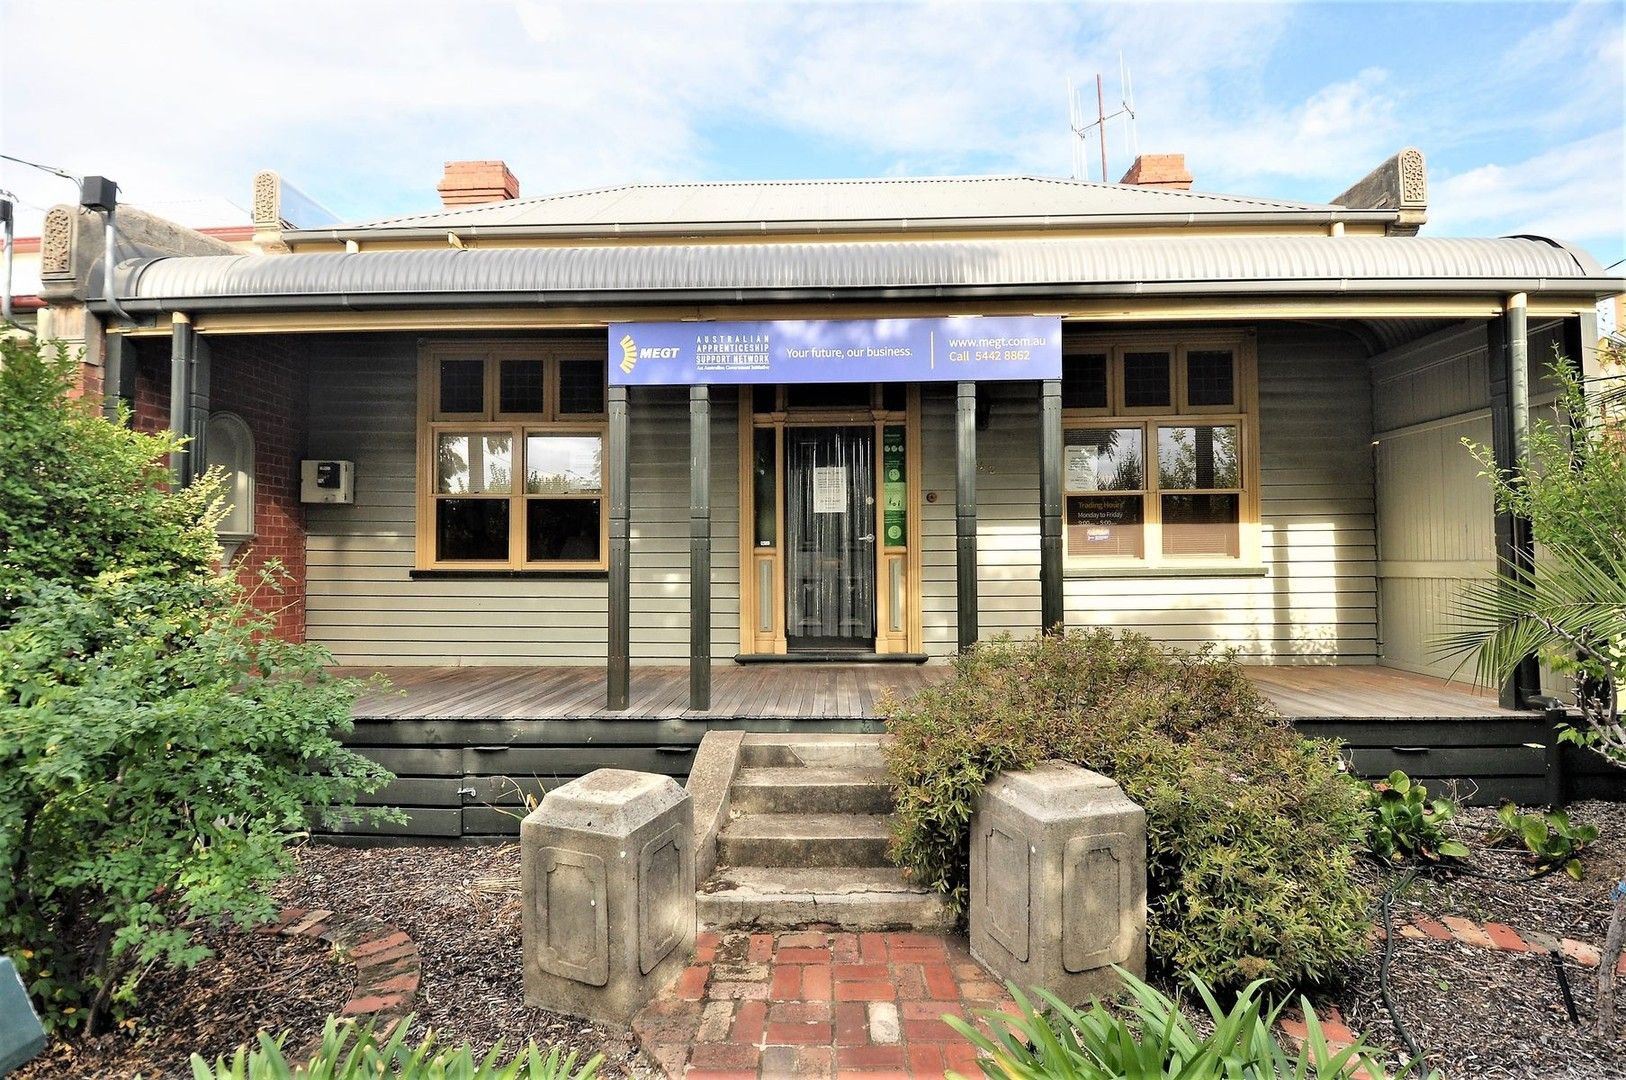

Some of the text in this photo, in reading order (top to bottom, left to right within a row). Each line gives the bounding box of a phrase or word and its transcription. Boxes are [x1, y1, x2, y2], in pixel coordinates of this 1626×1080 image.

[696, 335, 769, 344] AUSTRALIAN
[948, 336, 1046, 348] www.megt.com.au
[639, 348, 680, 358] MEGT
[696, 344, 769, 352] APPRENTICESHIP
[786, 346, 912, 359] Your future, our business.
[696, 354, 769, 364] SUPPORT NETWORK
[949, 350, 1030, 361] Call 5442 8862
